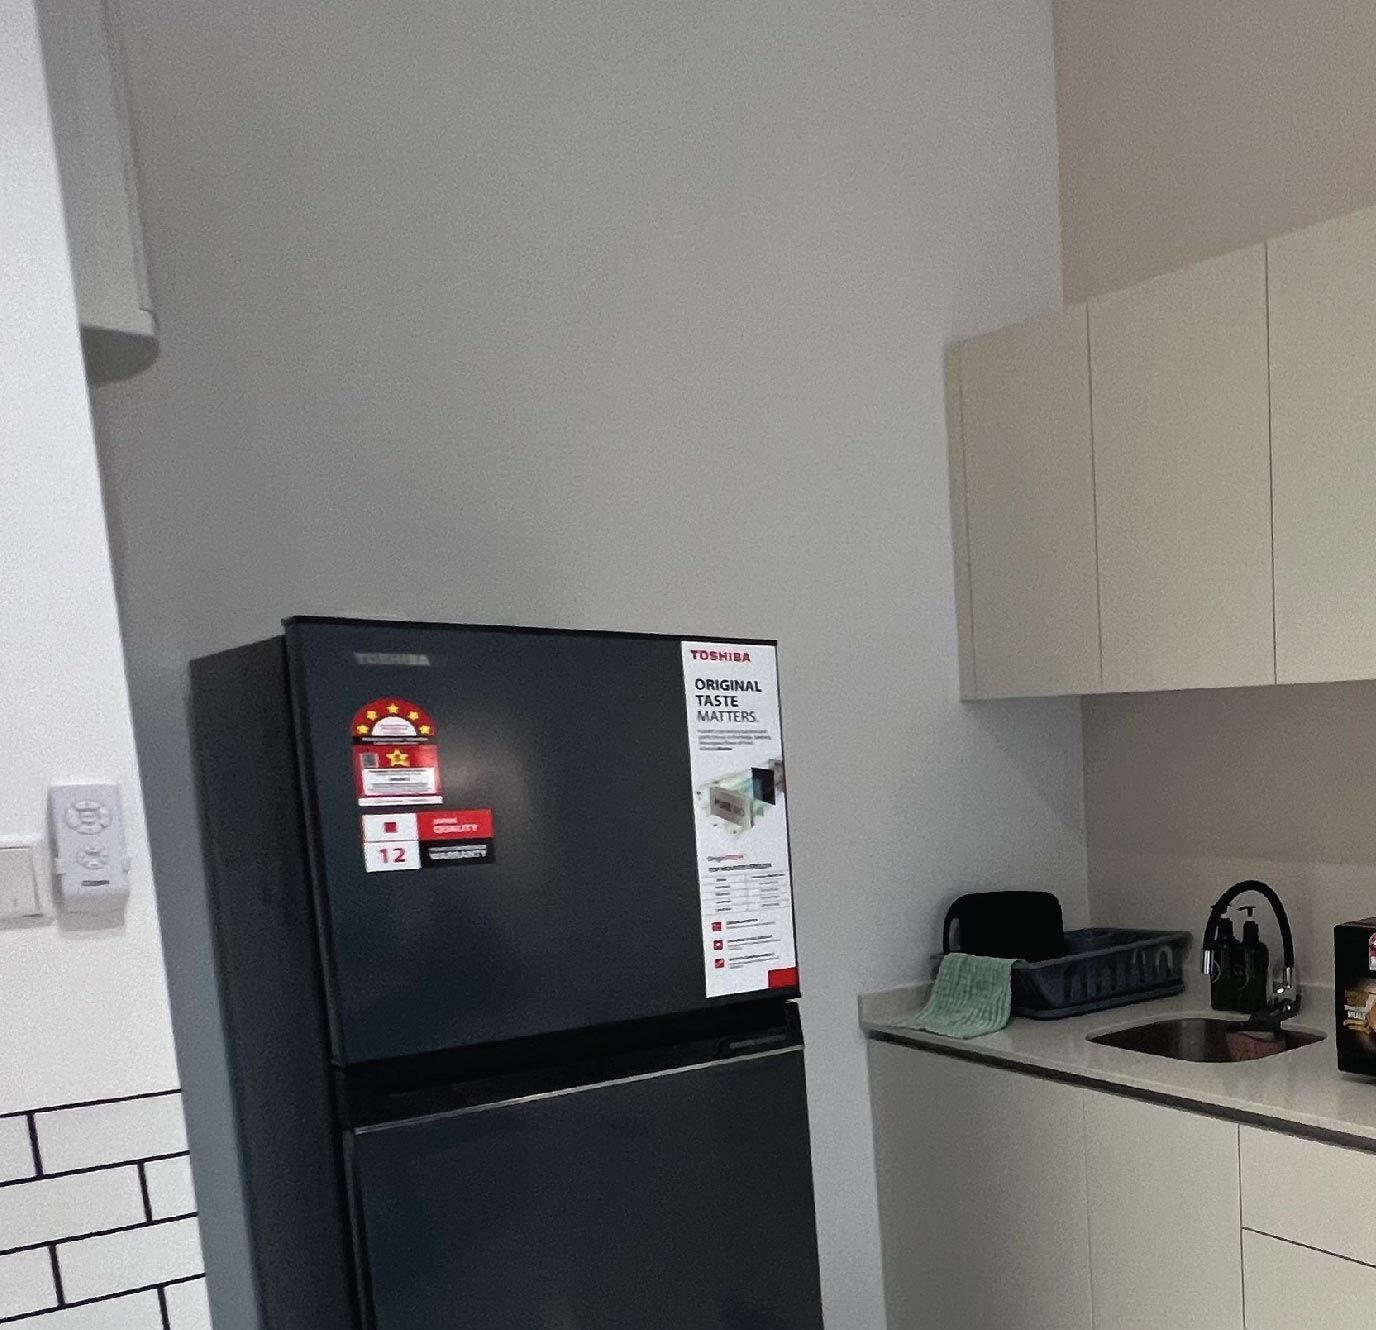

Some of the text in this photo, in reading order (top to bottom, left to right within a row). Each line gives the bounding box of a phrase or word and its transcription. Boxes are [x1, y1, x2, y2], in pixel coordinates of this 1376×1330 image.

[691, 650, 751, 662] TOSHIBA
[695, 678, 762, 692] ORIGINAL
[695, 695, 739, 707] TASTE
[433, 824, 478, 834] QUALITY
[378, 848, 406, 864] 12
